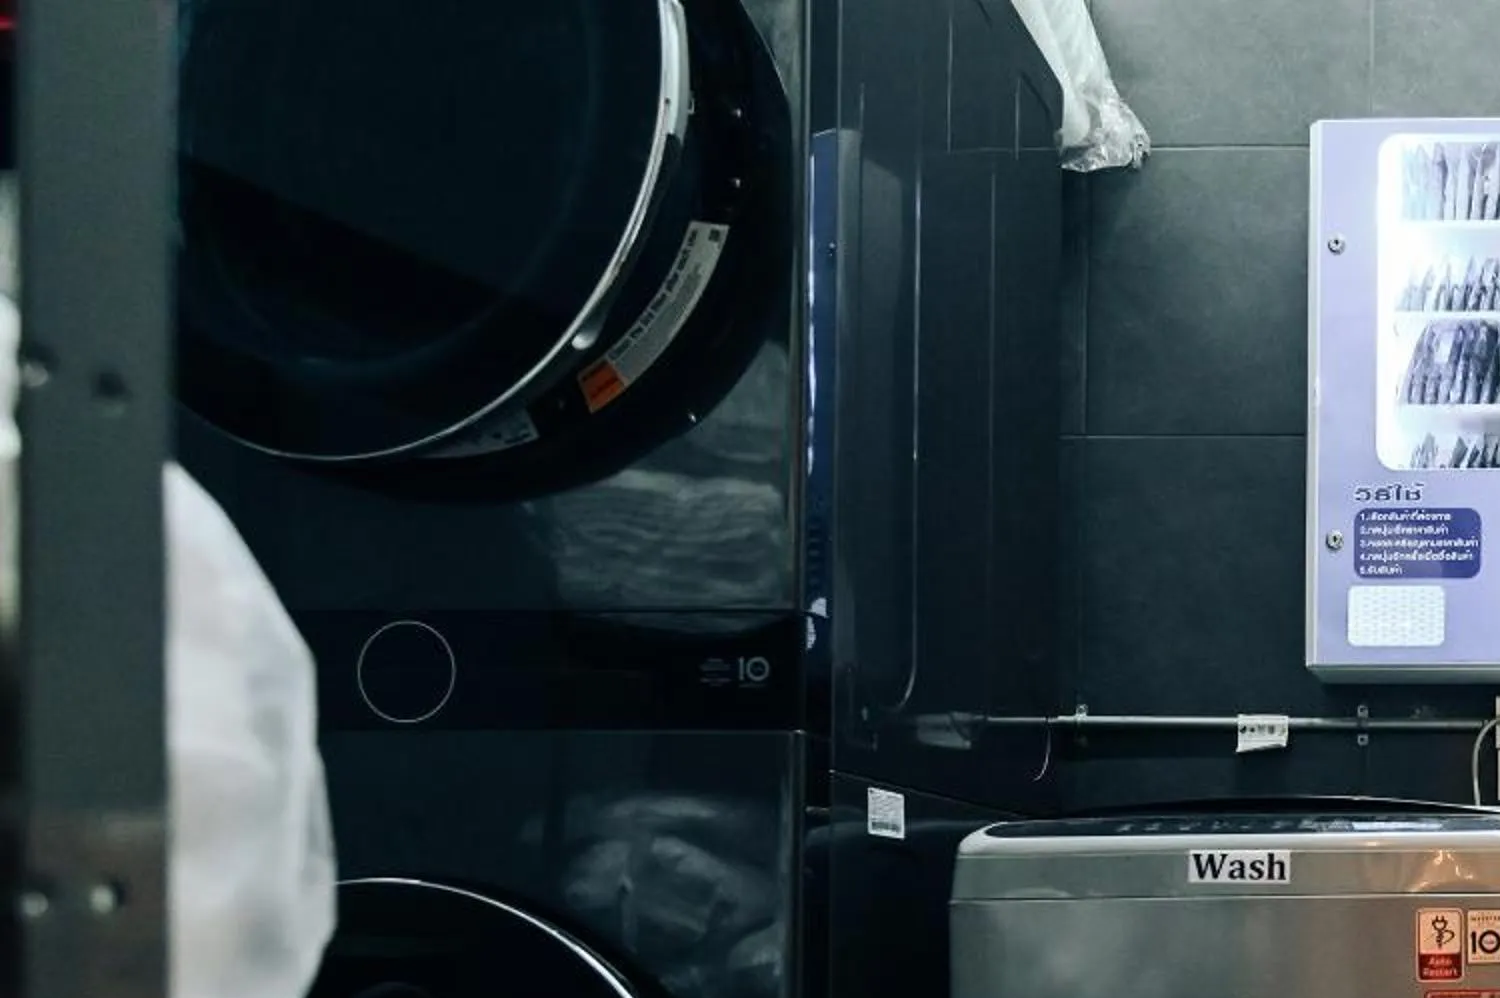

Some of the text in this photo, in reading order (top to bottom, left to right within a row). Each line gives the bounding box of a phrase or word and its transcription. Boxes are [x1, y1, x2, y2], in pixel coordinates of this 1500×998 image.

[738, 656, 770, 682] 10
[1192, 853, 1287, 880] Wash
[1471, 930, 1500, 953] 10
